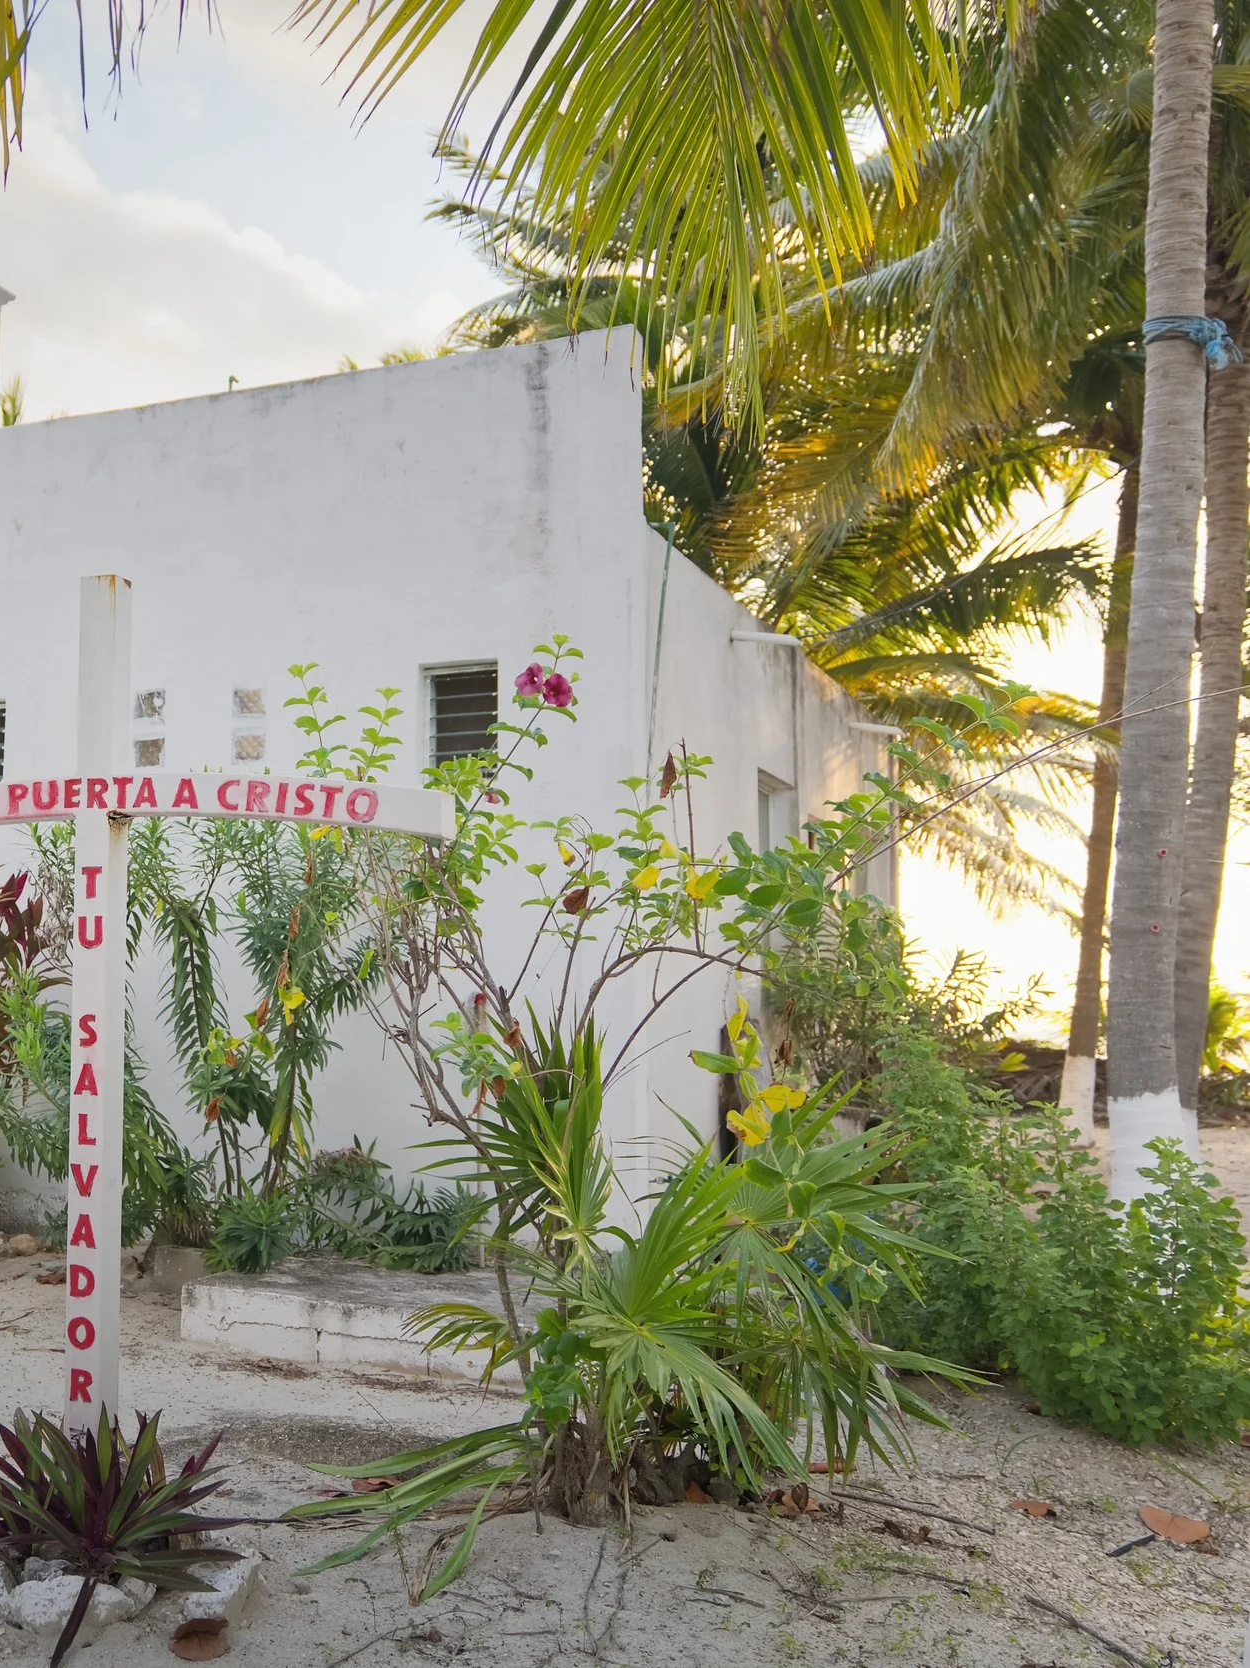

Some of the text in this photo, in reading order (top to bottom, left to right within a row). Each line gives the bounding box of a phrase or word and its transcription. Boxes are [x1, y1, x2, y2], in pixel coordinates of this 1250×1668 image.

[7, 777, 158, 815] PUERTA
[172, 778, 199, 810] A
[216, 779, 379, 823] CRISTO
[68, 866, 104, 1403] TU SALVADOR
